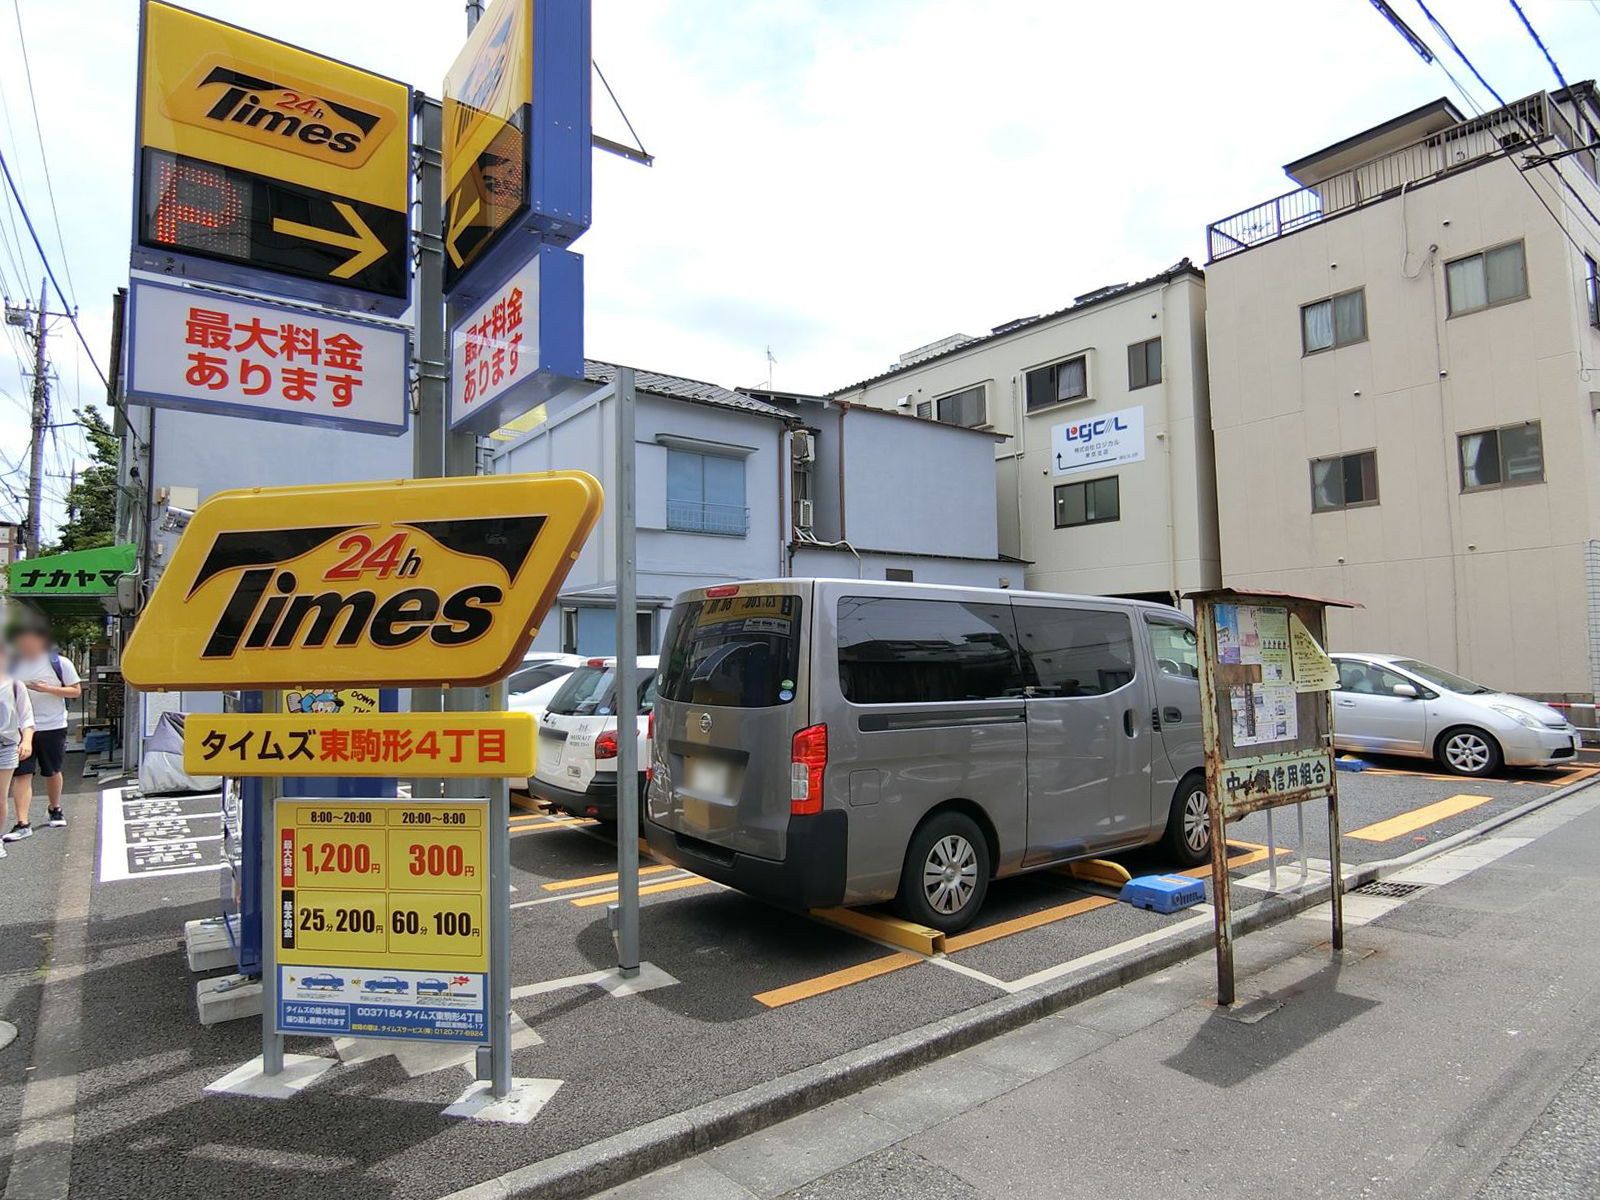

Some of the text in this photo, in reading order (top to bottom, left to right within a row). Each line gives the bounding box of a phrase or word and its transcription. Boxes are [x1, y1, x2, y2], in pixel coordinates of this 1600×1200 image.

[203, 84, 362, 153] Times
[276, 92, 325, 119] 24h
[157, 161, 243, 244] P
[186, 307, 363, 374] 最大料金
[465, 287, 523, 367] 最大料金
[186, 351, 363, 408] あります
[464, 332, 523, 404] あります
[20, 569, 124, 587] ナカヤマ
[323, 532, 421, 582] 24h
[198, 562, 504, 660] Times
[283, 901, 293, 938] 基本料金
